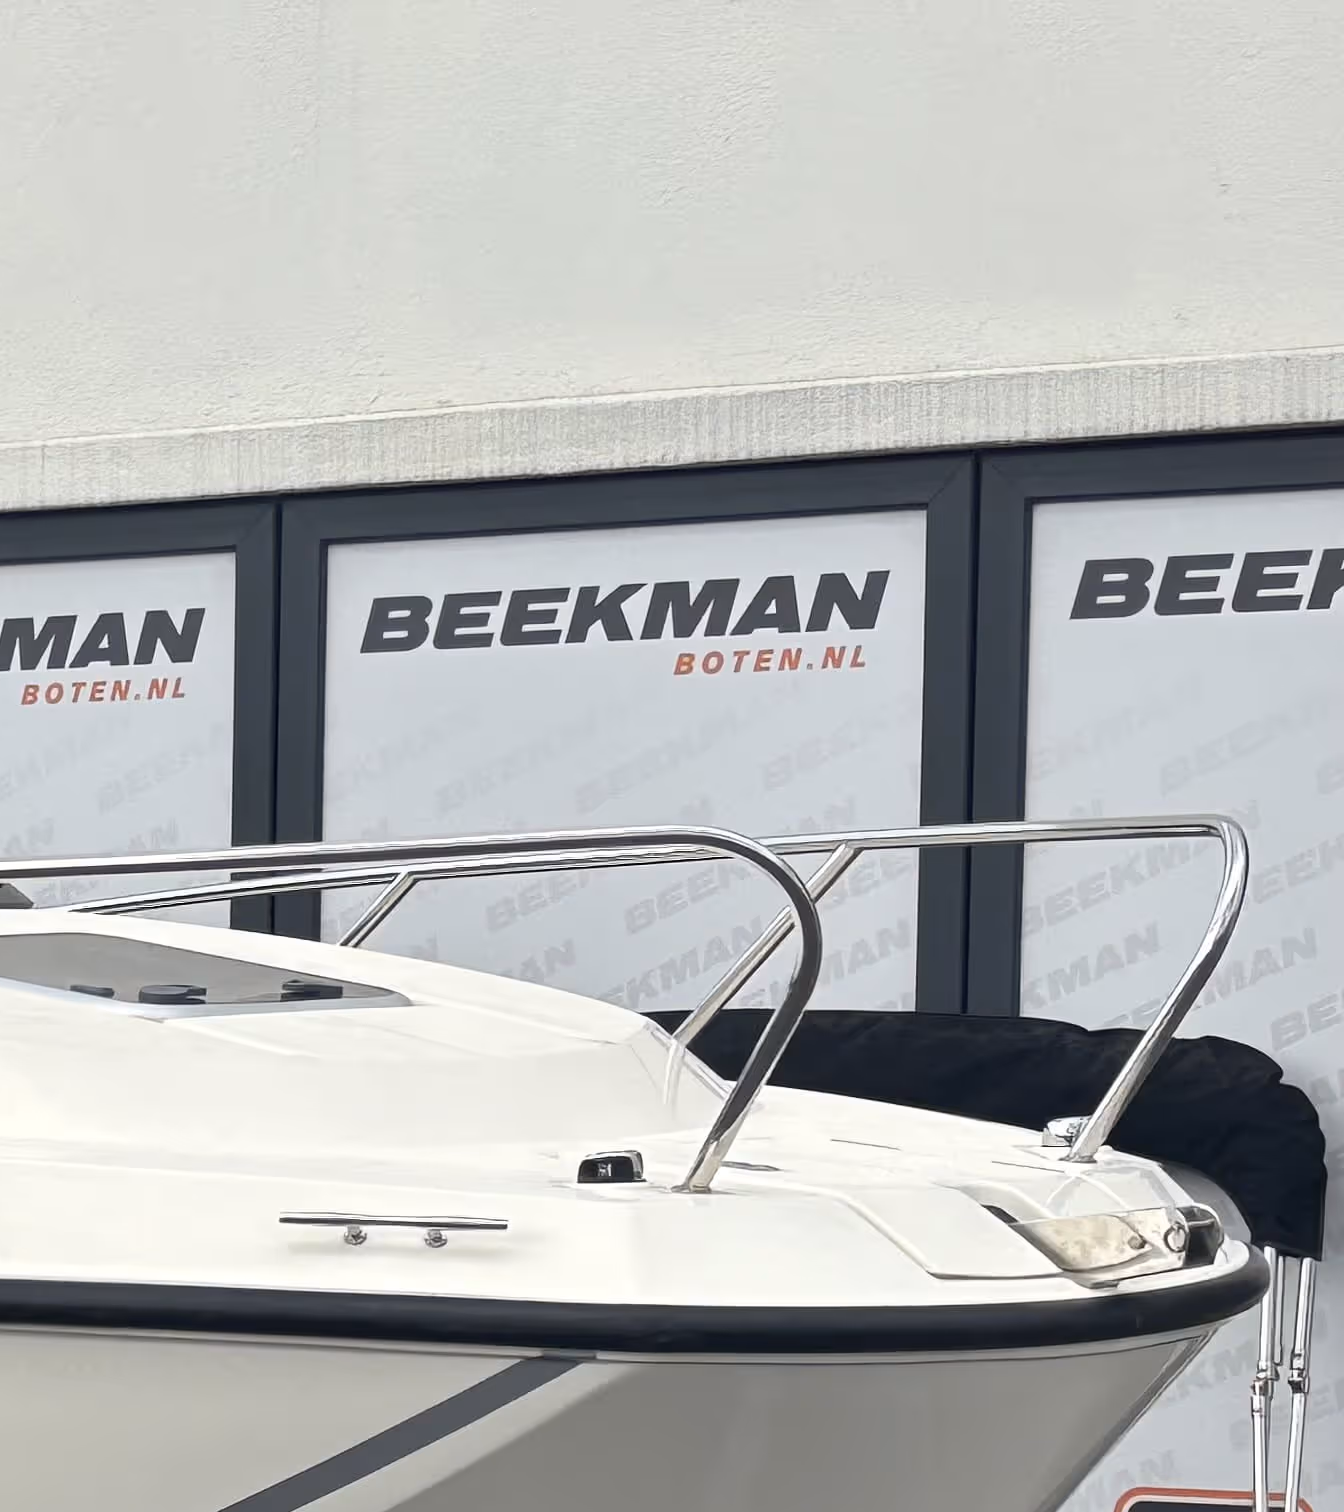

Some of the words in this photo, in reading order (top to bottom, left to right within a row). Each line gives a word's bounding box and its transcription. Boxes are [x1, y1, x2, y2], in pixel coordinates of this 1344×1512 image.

[359, 569, 892, 654] BEEKMAN
[672, 644, 869, 677] BOTEN.NL
[20, 676, 188, 706] BOTEN.NL
